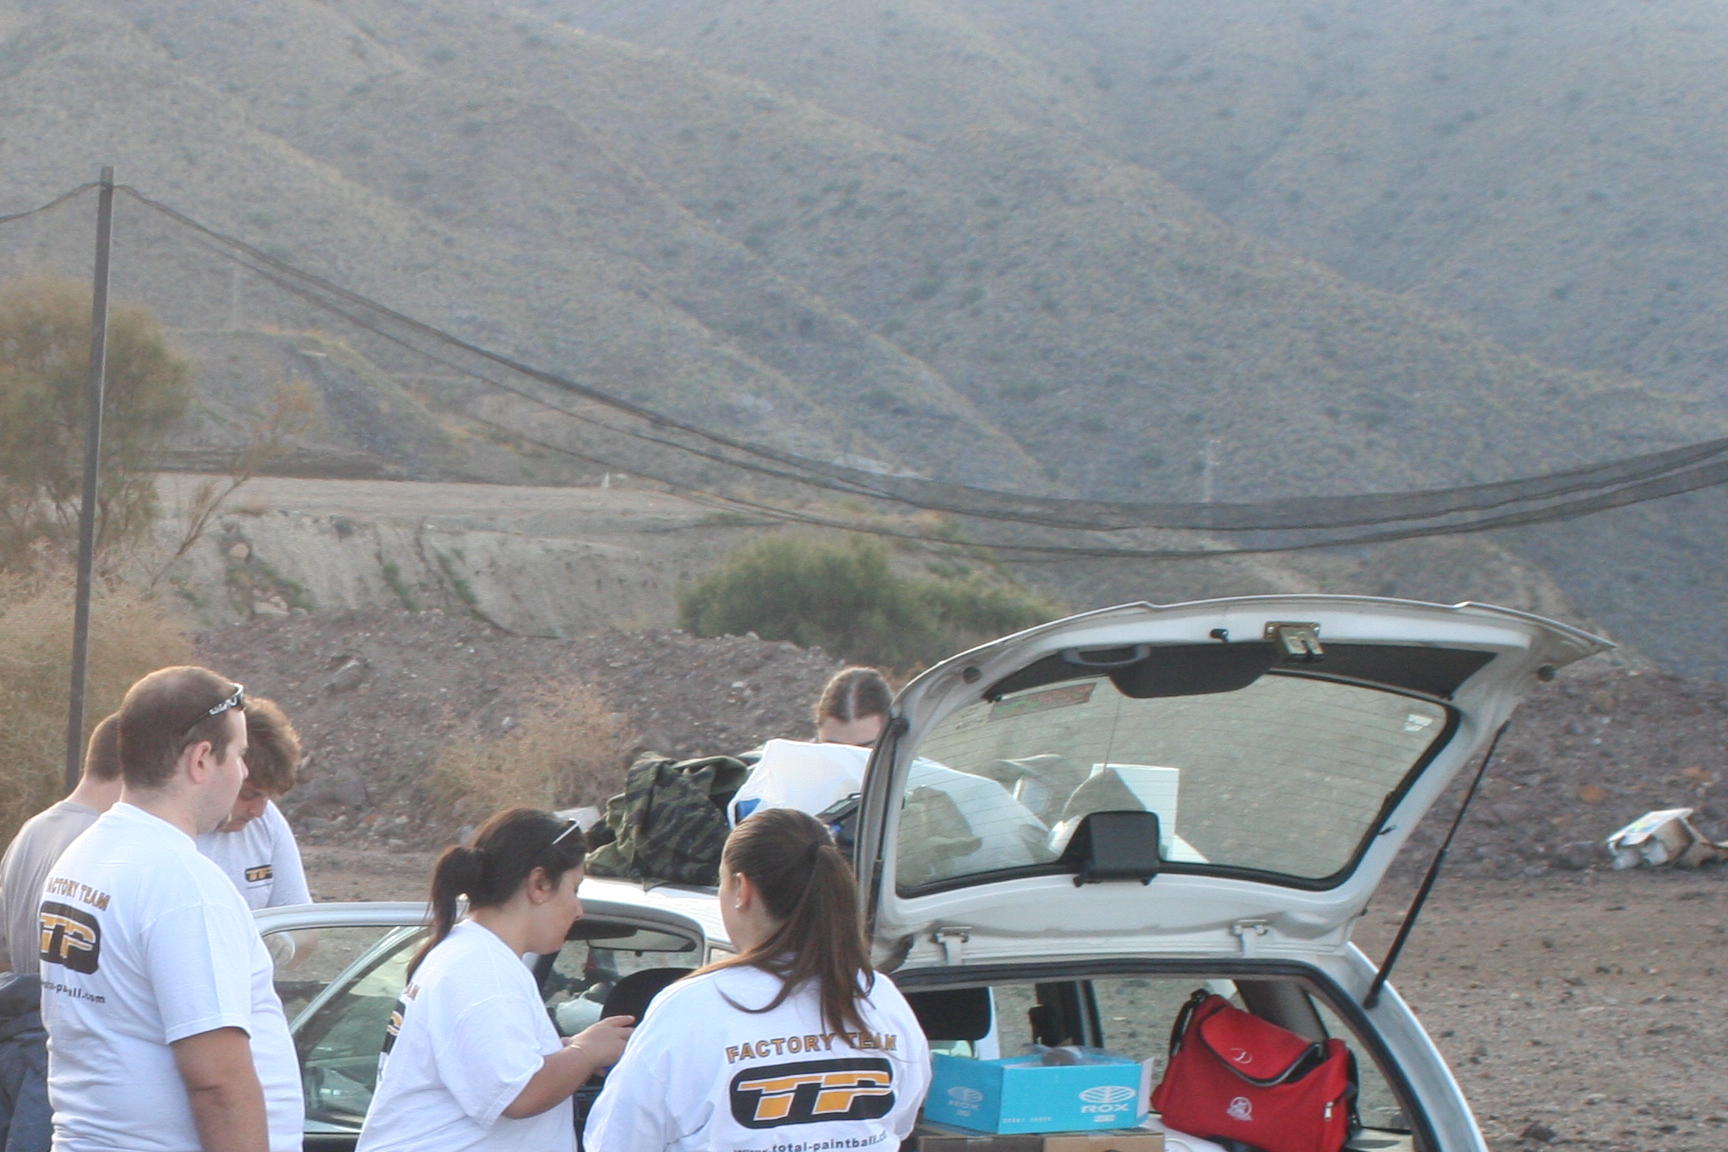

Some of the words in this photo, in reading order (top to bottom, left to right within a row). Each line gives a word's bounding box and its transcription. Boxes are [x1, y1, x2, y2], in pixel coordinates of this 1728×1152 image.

[46, 877, 80, 900] ACTORY
[79, 884, 112, 912] TEAM
[726, 1033, 835, 1064] FACTORY
[737, 1070, 894, 1122] TP
[1080, 1103, 1130, 1114] ROX
